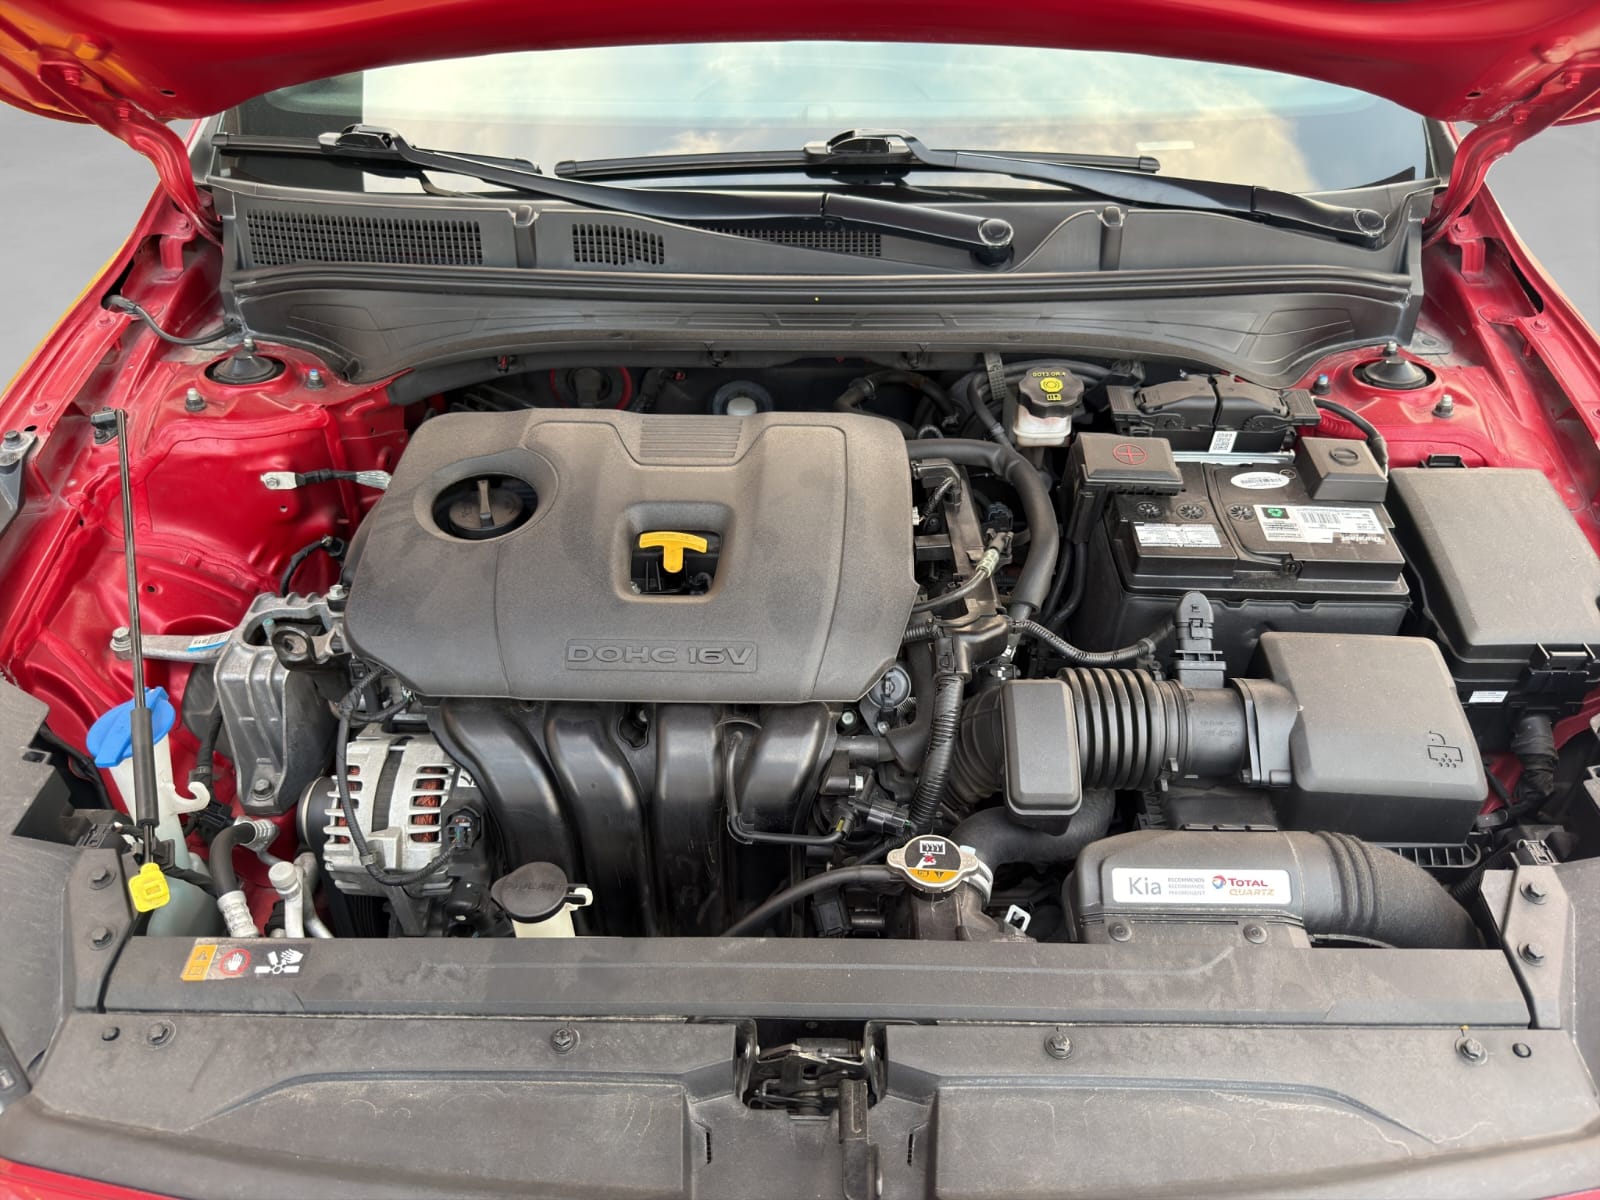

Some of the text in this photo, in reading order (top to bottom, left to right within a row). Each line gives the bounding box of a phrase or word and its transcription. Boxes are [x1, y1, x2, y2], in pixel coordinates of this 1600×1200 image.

[567, 645, 754, 665] DOHC 16V
[1128, 877, 1162, 895] Kia
[1227, 877, 1268, 887] TOTAL
[1229, 888, 1275, 896] QUARTZ
